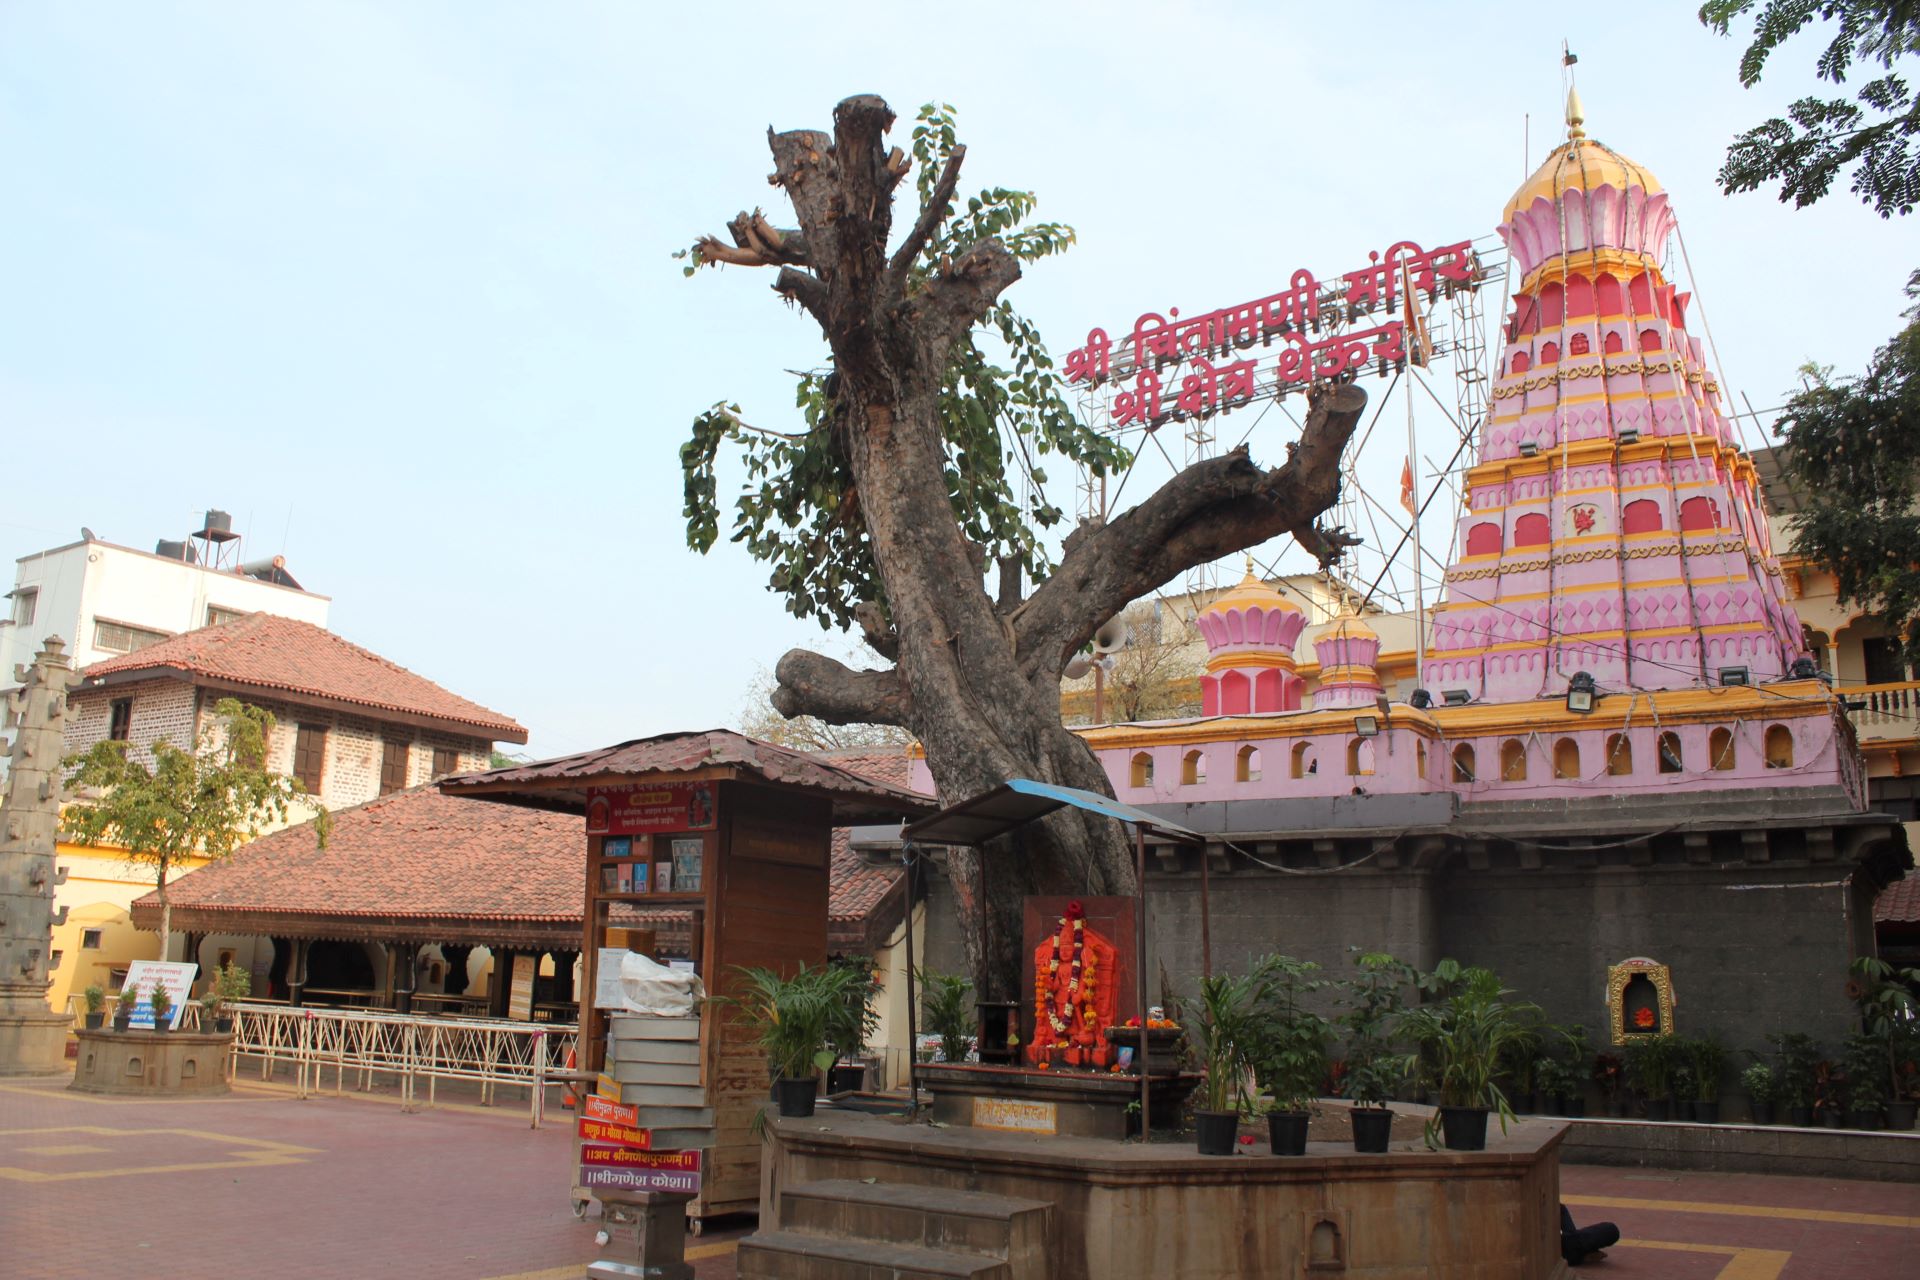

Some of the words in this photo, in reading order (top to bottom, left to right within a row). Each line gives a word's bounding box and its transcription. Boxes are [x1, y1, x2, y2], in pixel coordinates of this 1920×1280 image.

[1063, 327, 1112, 384] श्री
[1134, 268, 1321, 366] चिंतामणी
[1343, 239, 1473, 305] मंदिर
[1111, 368, 1163, 427] श्री
[1177, 356, 1258, 414] क्षेत्र
[1279, 320, 1407, 383] थेऊर
